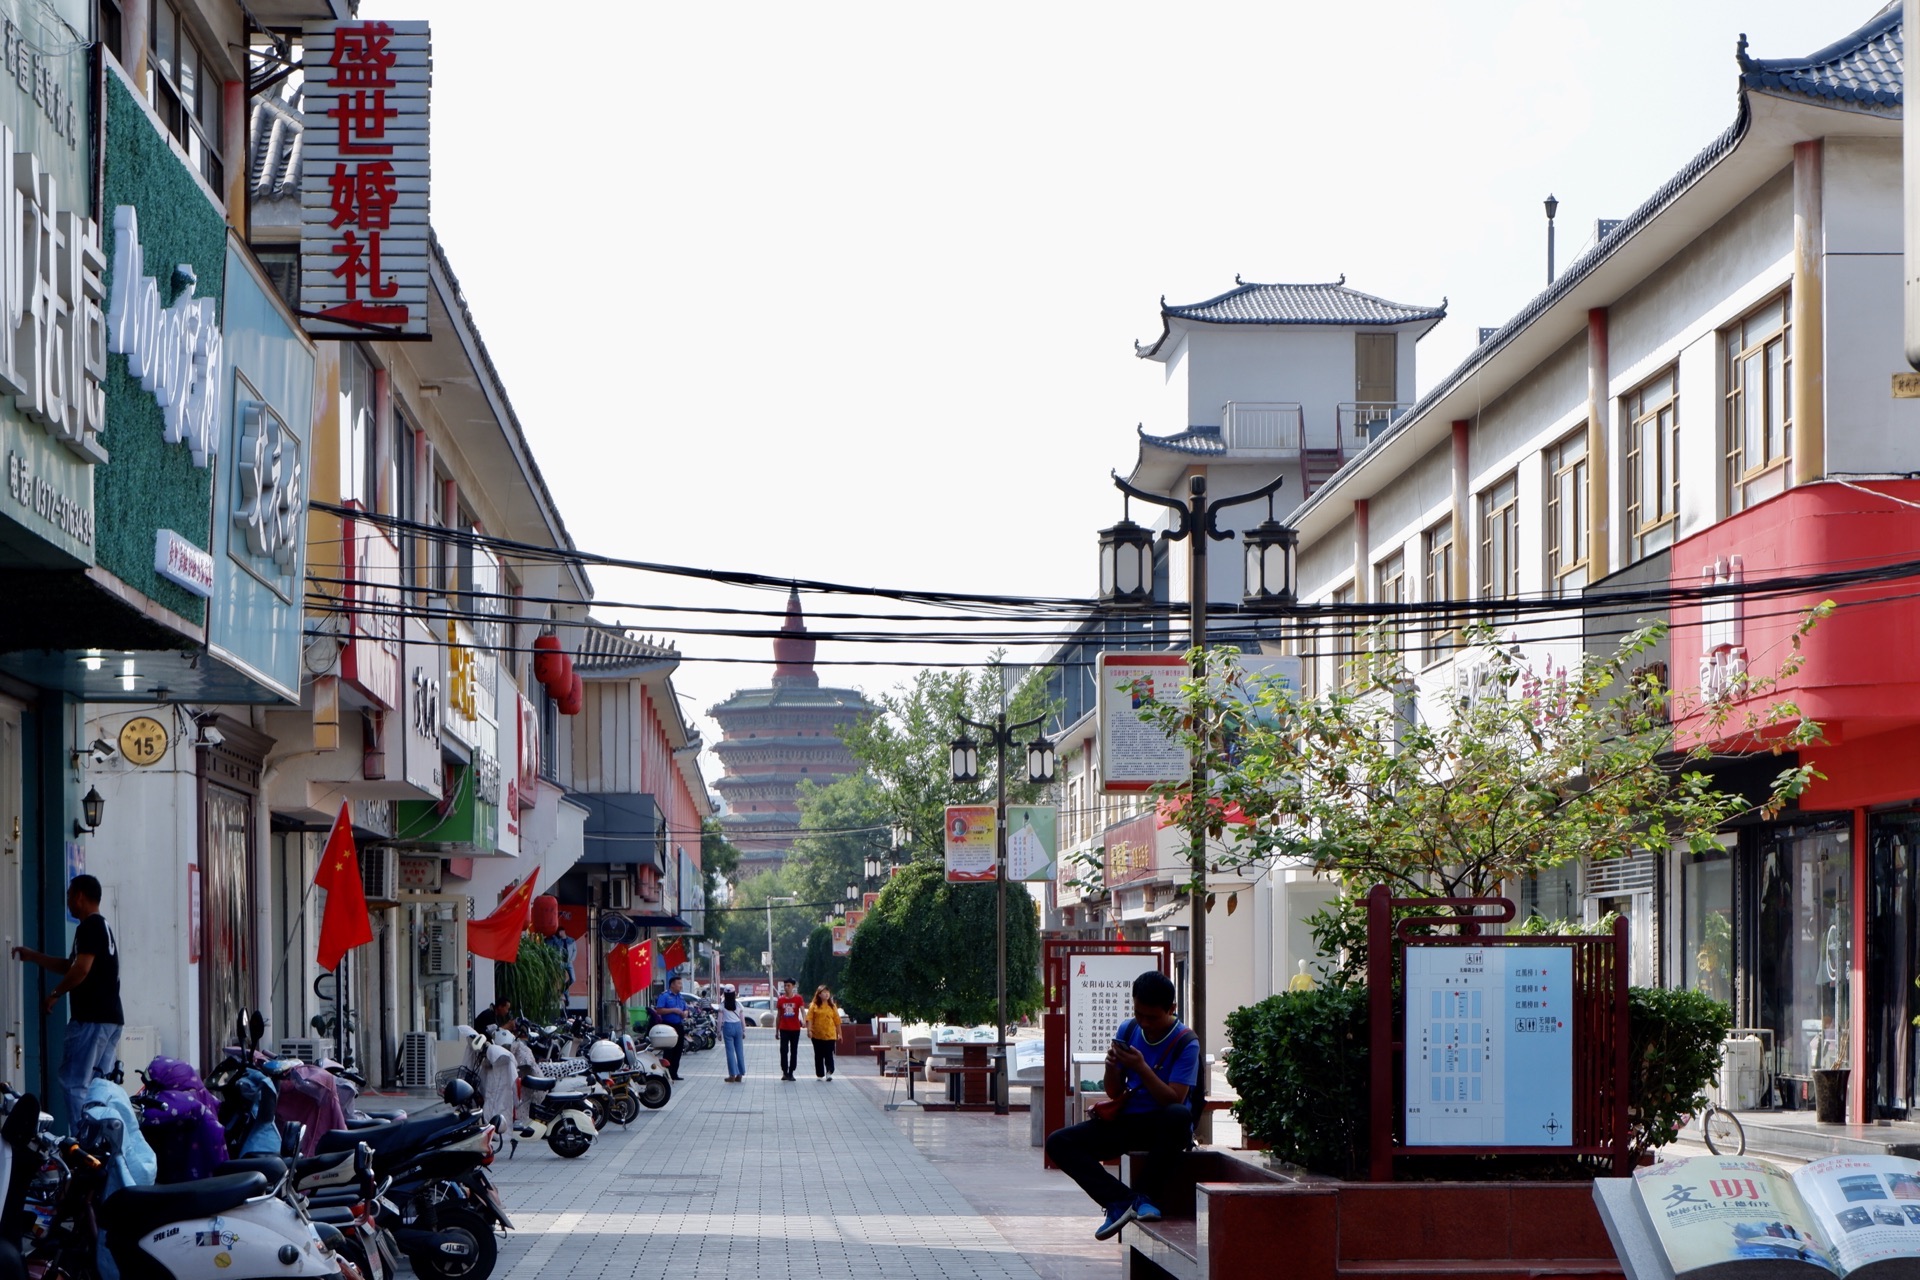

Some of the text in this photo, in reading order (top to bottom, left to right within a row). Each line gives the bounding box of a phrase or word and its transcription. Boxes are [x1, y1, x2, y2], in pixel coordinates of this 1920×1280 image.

[328, 20, 399, 300] 盛世婚礼
[35, 475, 95, 546] 0372-3763439
[134, 737, 155, 756] 15
[1081, 980, 1134, 989] 安阳市民文明
[1539, 1016, 1556, 1024] 无障碍
[1539, 1025, 1556, 1033] 卫生间
[1662, 1178, 1760, 1210] 文明
[1666, 1202, 1716, 1218] 彬彬有礼
[1722, 1200, 1771, 1208] 仁德有序
